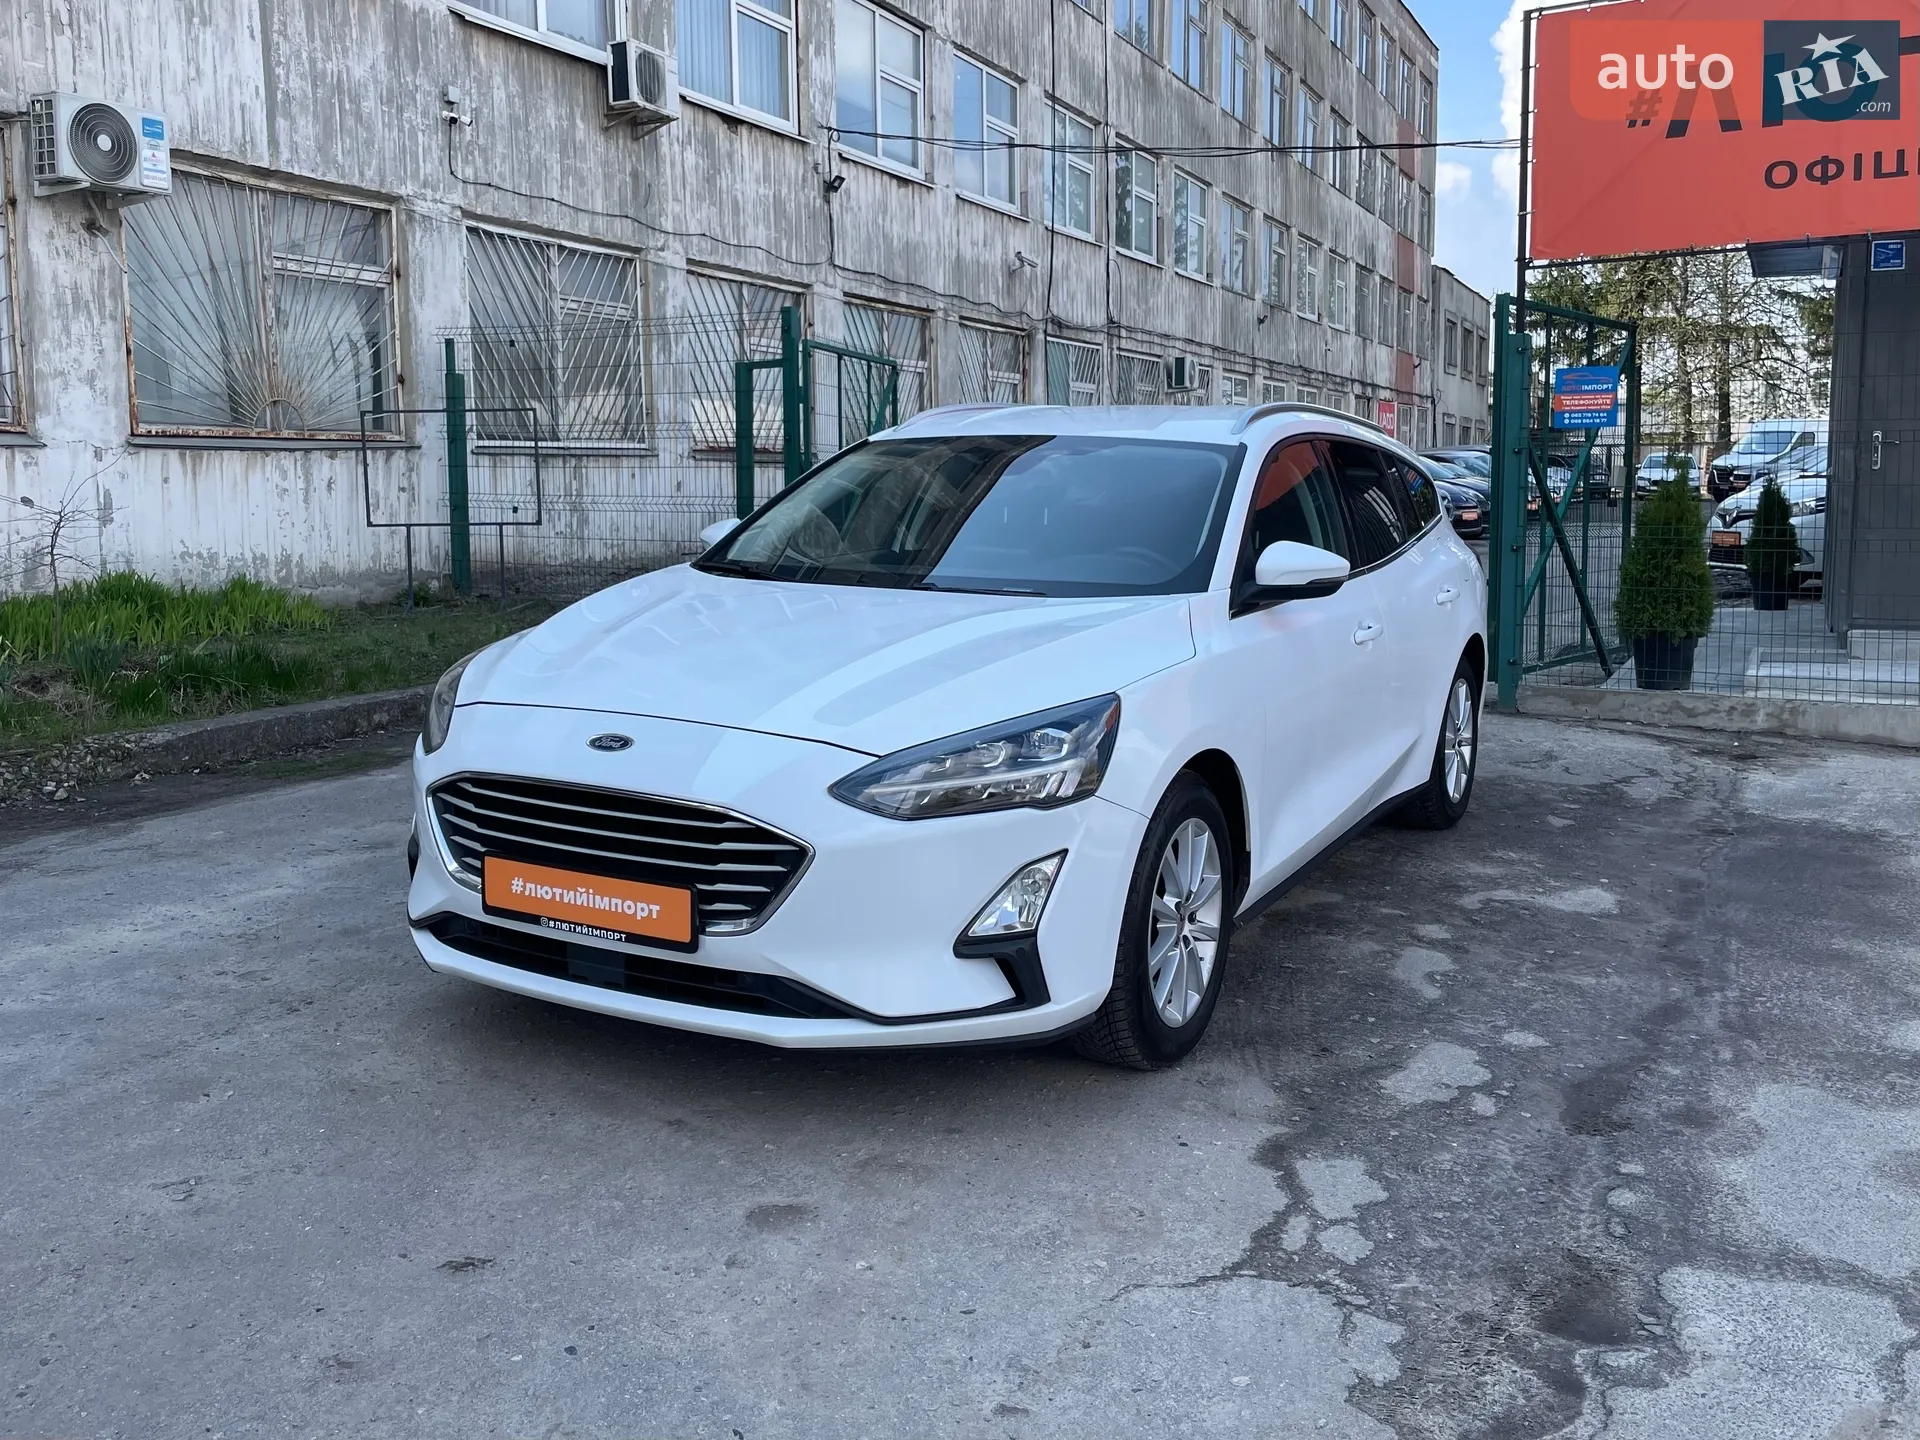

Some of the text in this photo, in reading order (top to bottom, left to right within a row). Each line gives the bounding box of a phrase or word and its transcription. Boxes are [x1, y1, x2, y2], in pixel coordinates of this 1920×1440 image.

[1764, 147, 1920, 190] ОФІЦ
[595, 736, 625, 748] Ford
[511, 877, 661, 919] #лютийімпорт
